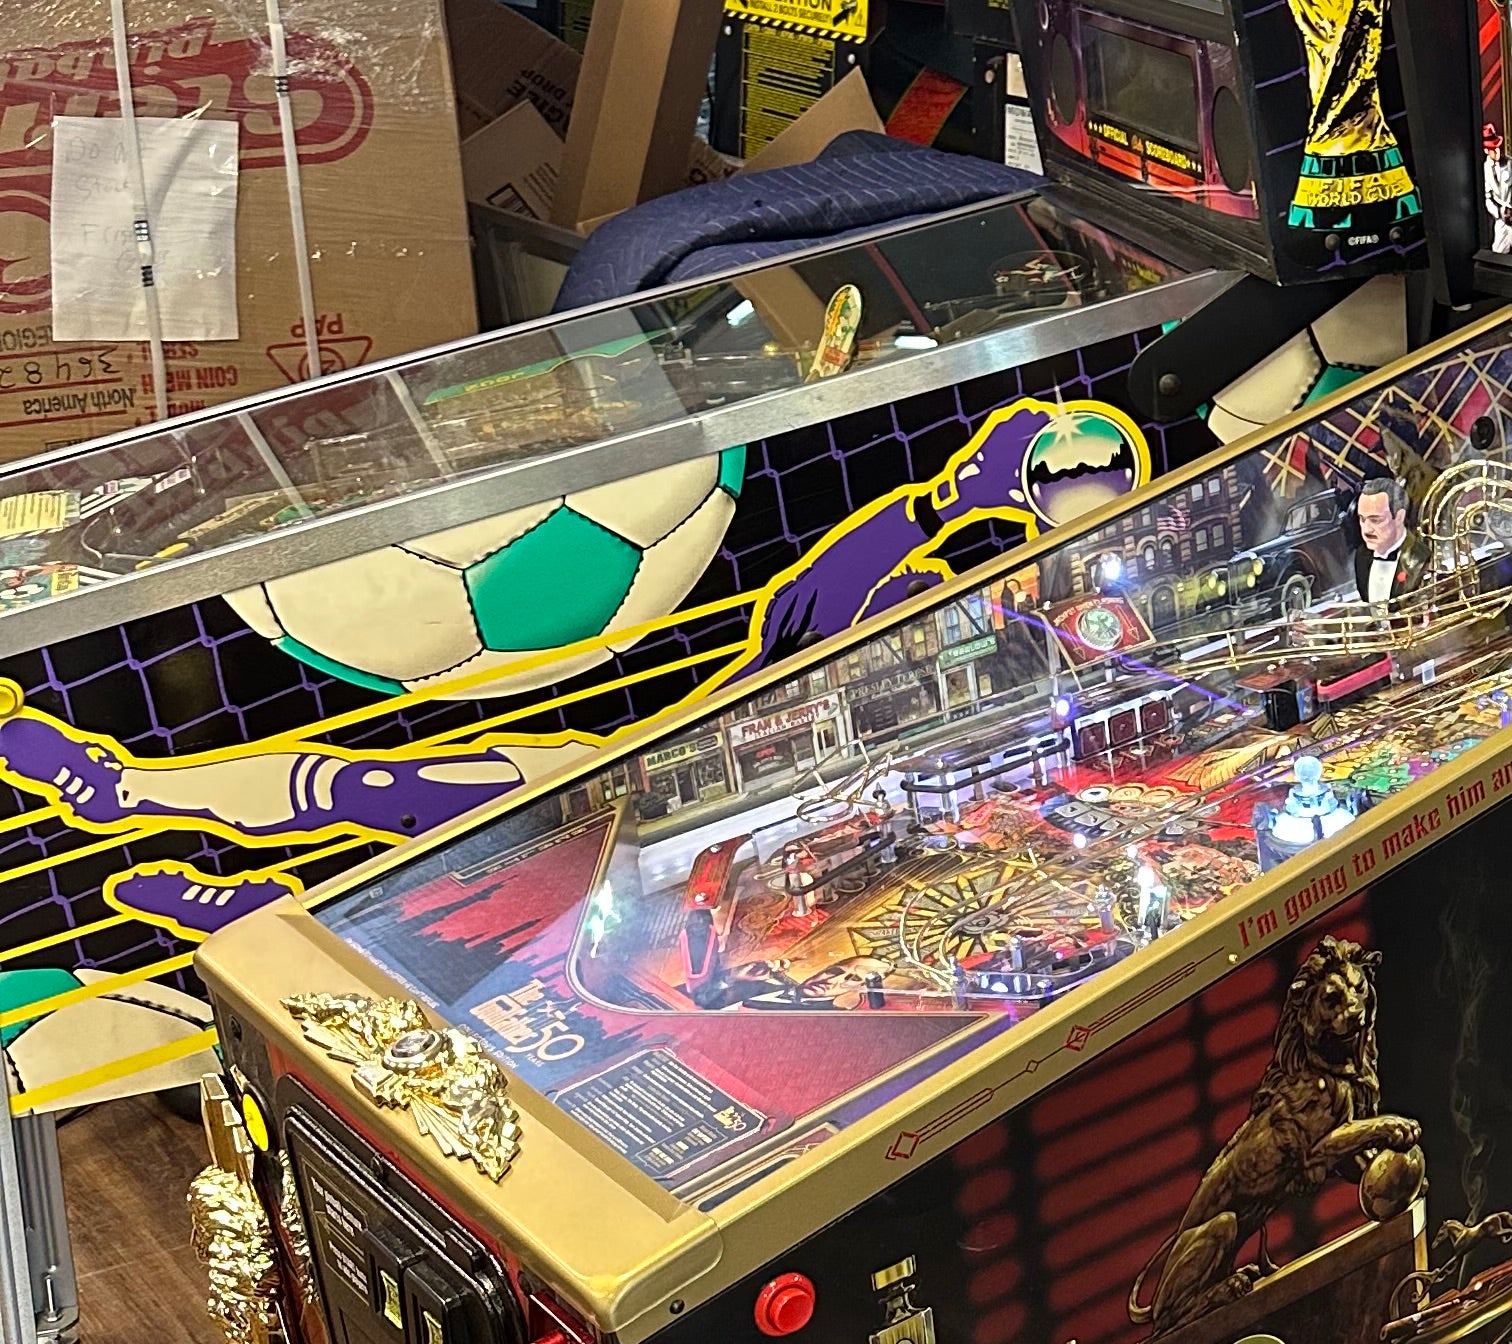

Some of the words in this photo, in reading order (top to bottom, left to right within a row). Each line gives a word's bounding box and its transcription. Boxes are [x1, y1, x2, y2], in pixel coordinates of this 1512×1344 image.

[1103, 123, 1129, 146] OFFICIAL
[1145, 141, 1188, 170] SCOREBOARD
[1307, 190, 1362, 208] WORLD
[1368, 183, 1404, 203] CUP
[1320, 176, 1383, 194] FIFA
[141, 367, 192, 394] MEH
[195, 365, 238, 389] COIN
[22, 391, 87, 419] America
[88, 387, 136, 414] North
[646, 741, 697, 768] MARCO'S
[1238, 905, 1279, 950] I'm
[1284, 863, 1347, 925] going
[1353, 846, 1377, 876] to
[1380, 806, 1442, 855] make
[1445, 782, 1487, 817] him
[508, 978, 546, 1006] The
[469, 994, 538, 1046] Godfather
[504, 1020, 585, 1061] 50
